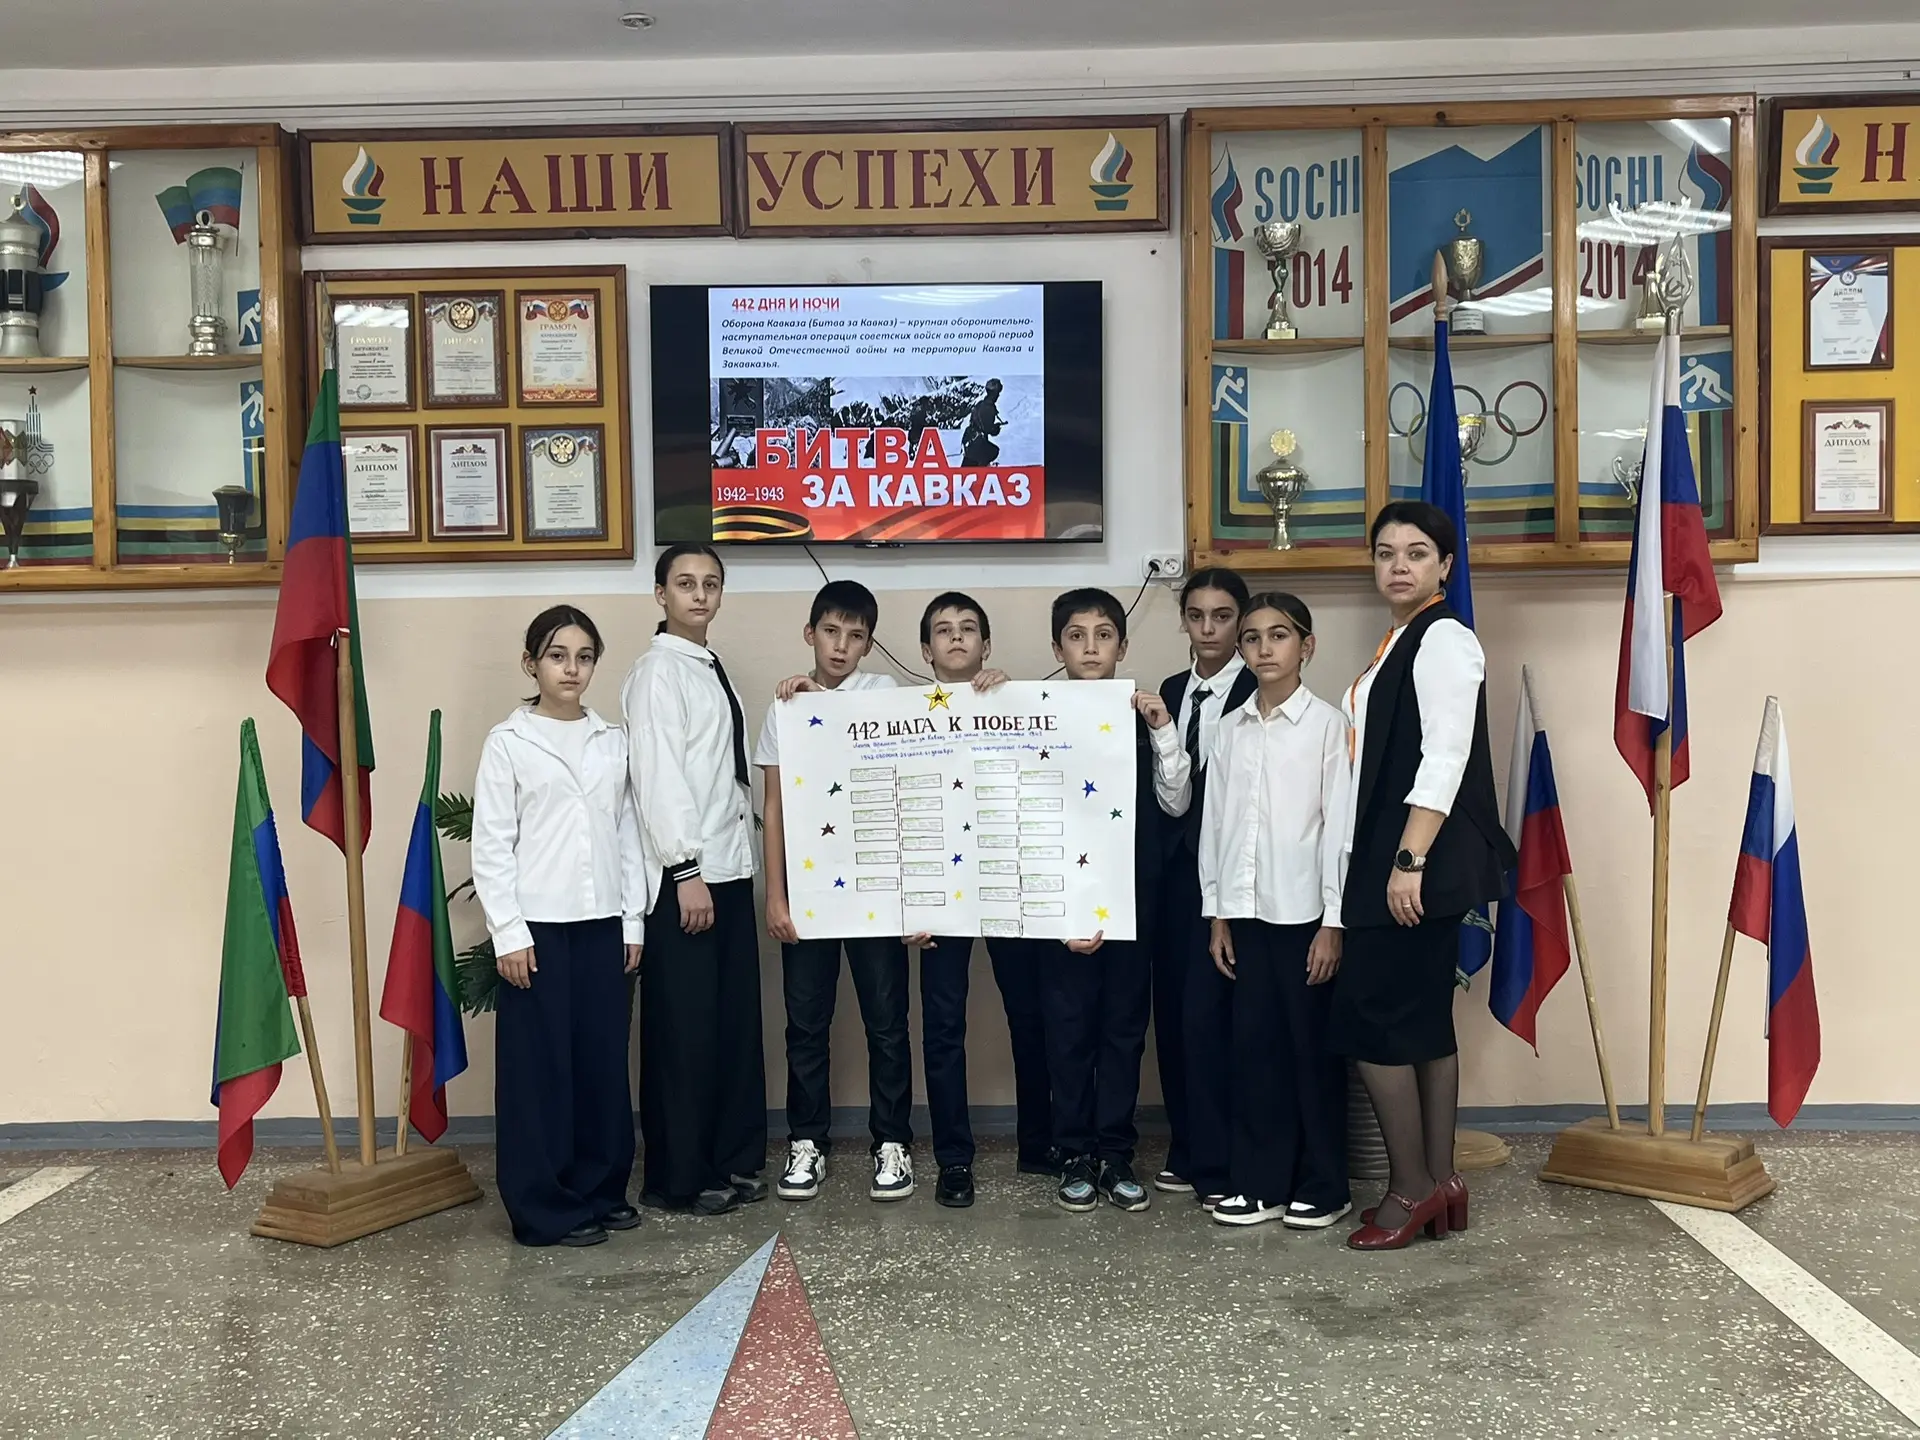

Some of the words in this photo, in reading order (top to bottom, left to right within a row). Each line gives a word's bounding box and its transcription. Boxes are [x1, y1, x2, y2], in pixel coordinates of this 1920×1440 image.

[1860, 122, 1920, 183] Н
[420, 152, 673, 215] НАШИ
[747, 147, 1056, 212] УСПЕХИ
[1255, 155, 1360, 223] SOCHI
[732, 298, 754, 310] 442
[758, 298, 786, 311] ДНЯ
[790, 298, 798, 309] И
[803, 298, 840, 310] НОЧИ
[540, 323, 577, 331] ГРАМОТА
[722, 319, 765, 329] Оборона
[767, 319, 806, 328] Кавказа
[808, 318, 845, 329] (Битва
[861, 318, 898, 328] Кавказ)
[908, 319, 948, 328] крупная
[951, 317, 1034, 327] оборонительно-
[722, 333, 808, 342] наступательная
[810, 333, 857, 342] операция
[860, 332, 911, 340] советских
[914, 331, 941, 340] войск
[958, 330, 996, 341] второй
[999, 330, 1034, 341] период
[722, 346, 763, 355] Великой
[769, 346, 850, 355] Отечественной
[856, 346, 887, 354] войны
[911, 345, 976, 355] территории
[982, 344, 1022, 352] Кавказа
[722, 360, 780, 369] Закавказья.
[755, 427, 950, 468] БИТВА
[1824, 439, 1871, 447] ДИПЛОМ
[354, 463, 397, 472] ДИПЛОМ
[450, 461, 488, 469] ДИПЛОМ
[801, 474, 856, 508] ЗА
[868, 473, 1031, 508] КАВКАЗ
[847, 721, 881, 741] 442
[887, 718, 938, 736] ШАГА
[948, 716, 962, 732] К
[973, 715, 1058, 731] ПОБЕДЕ
